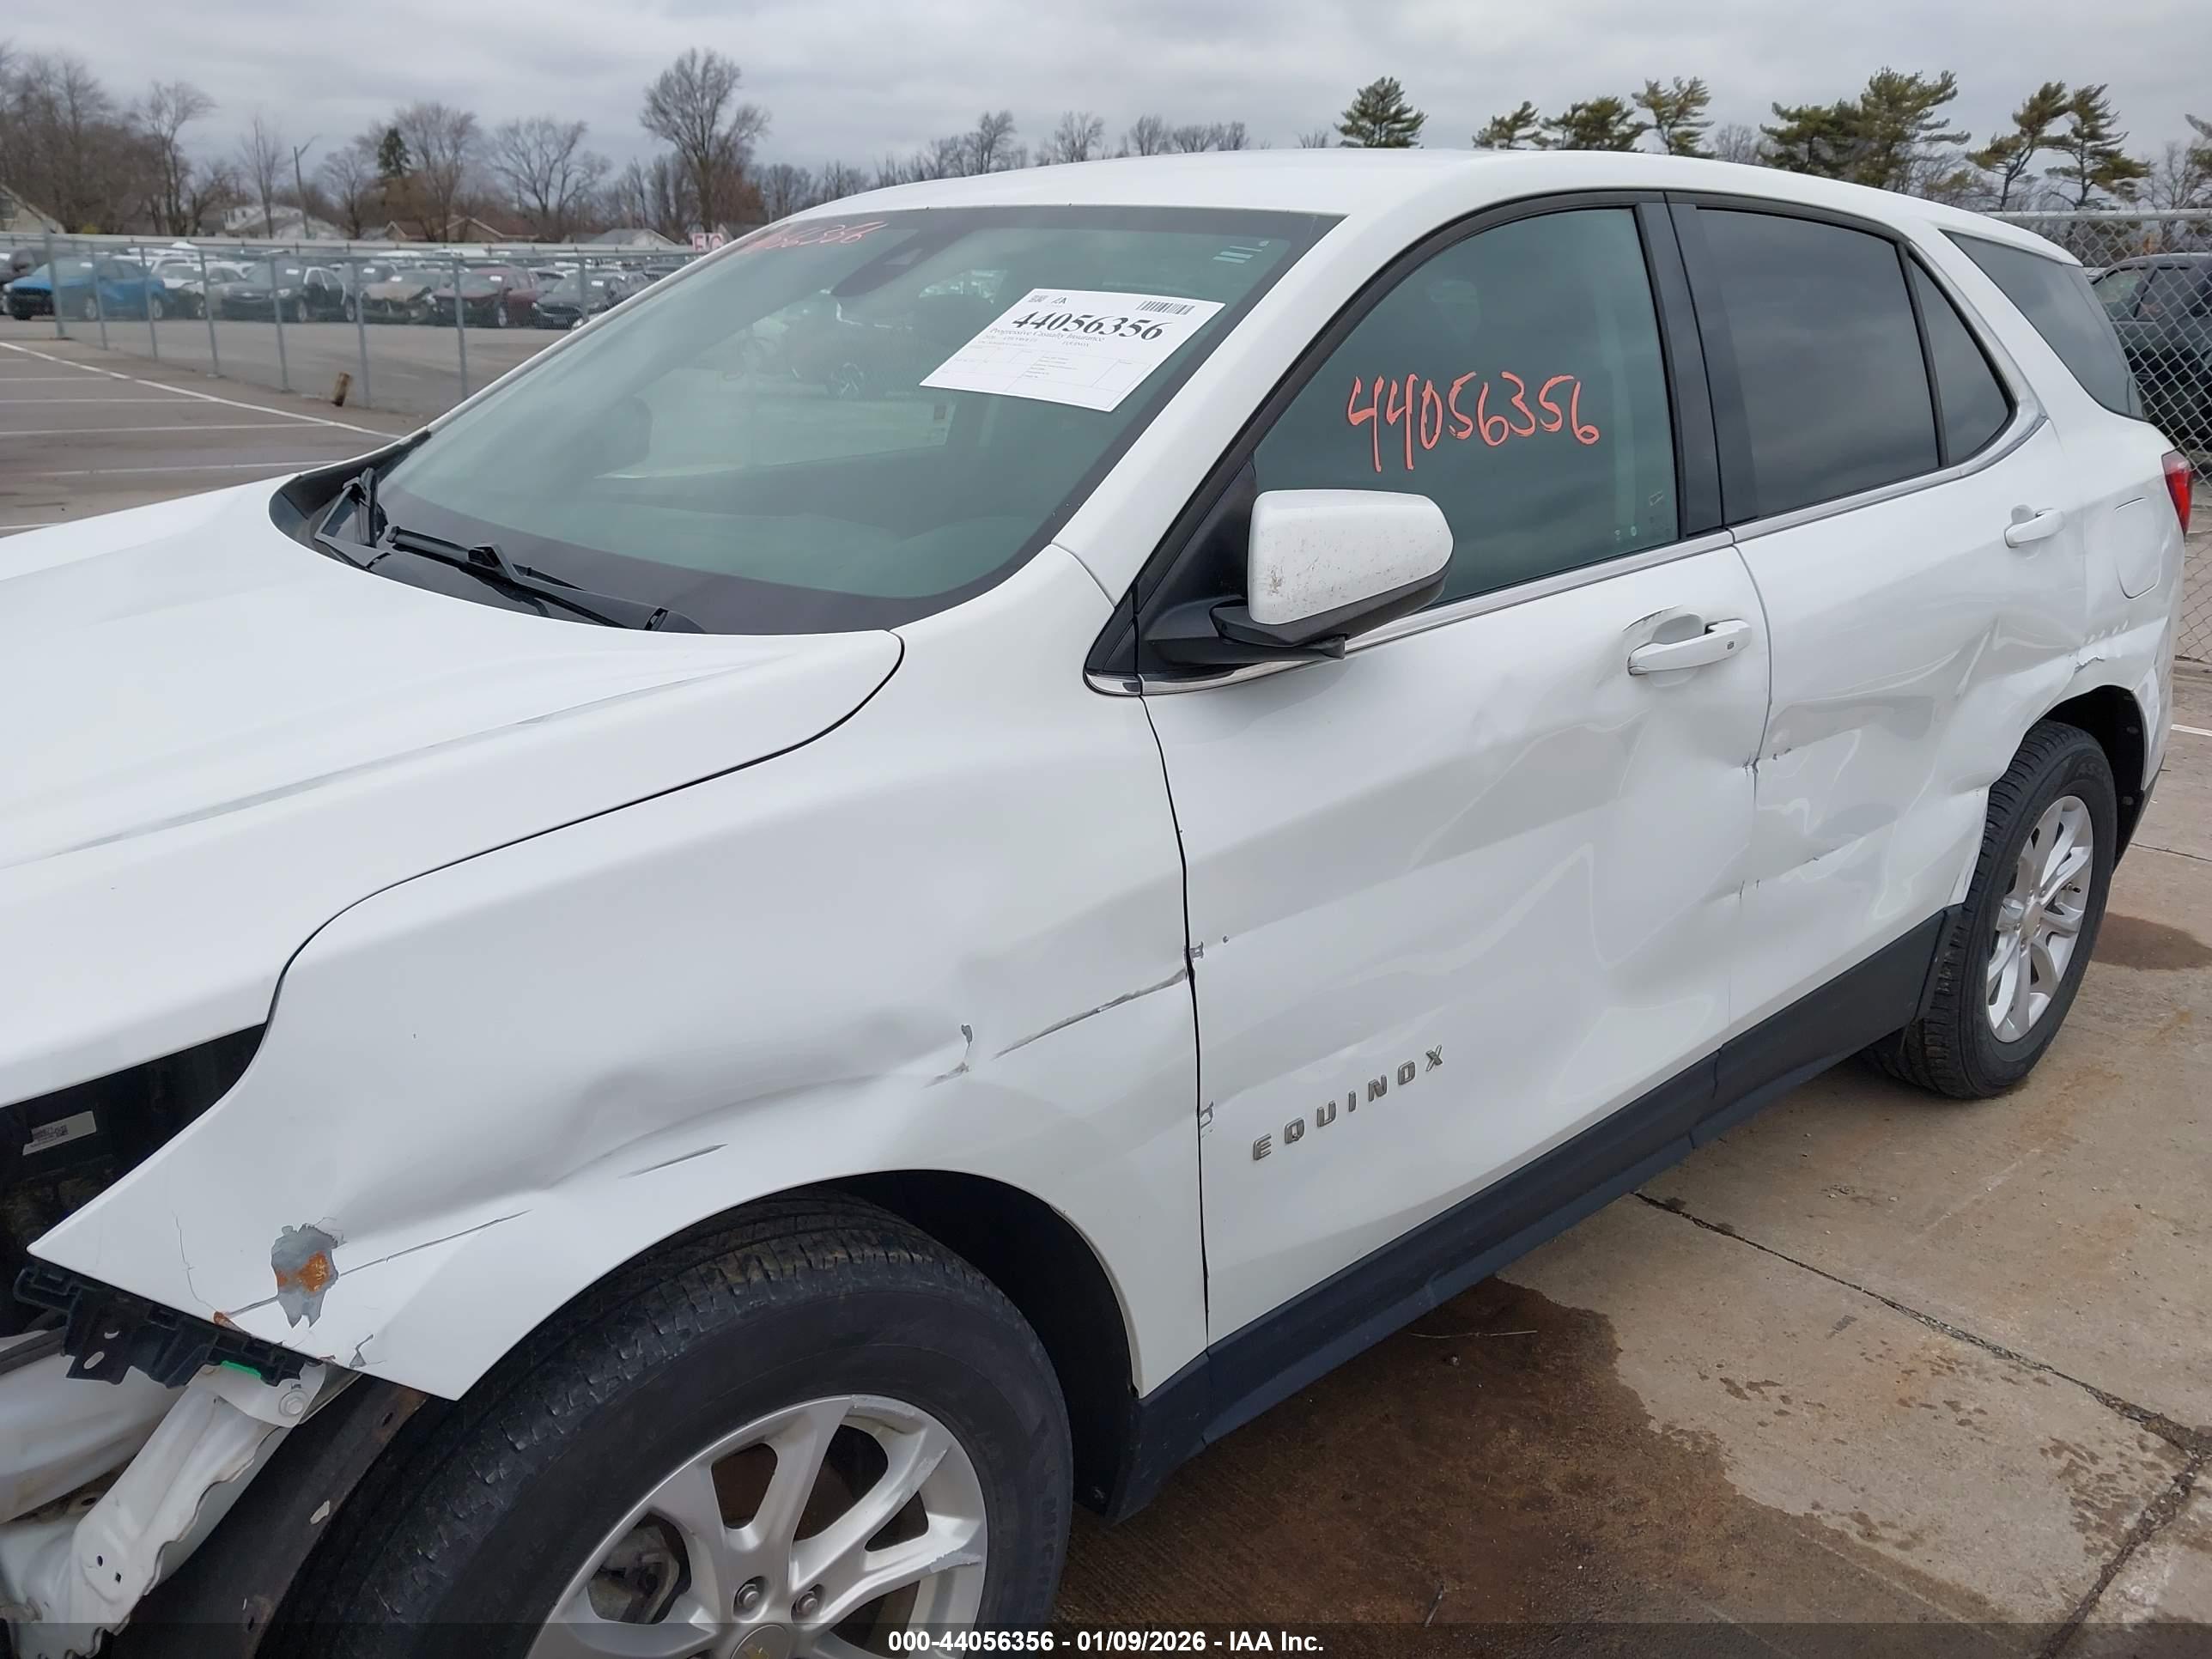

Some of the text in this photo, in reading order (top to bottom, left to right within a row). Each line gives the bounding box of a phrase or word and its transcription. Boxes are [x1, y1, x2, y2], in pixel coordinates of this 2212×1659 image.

[1012, 310, 1174, 341] 44056356
[1347, 371, 1600, 472] 44056356
[1253, 1044, 1443, 1161] EQUINOX
